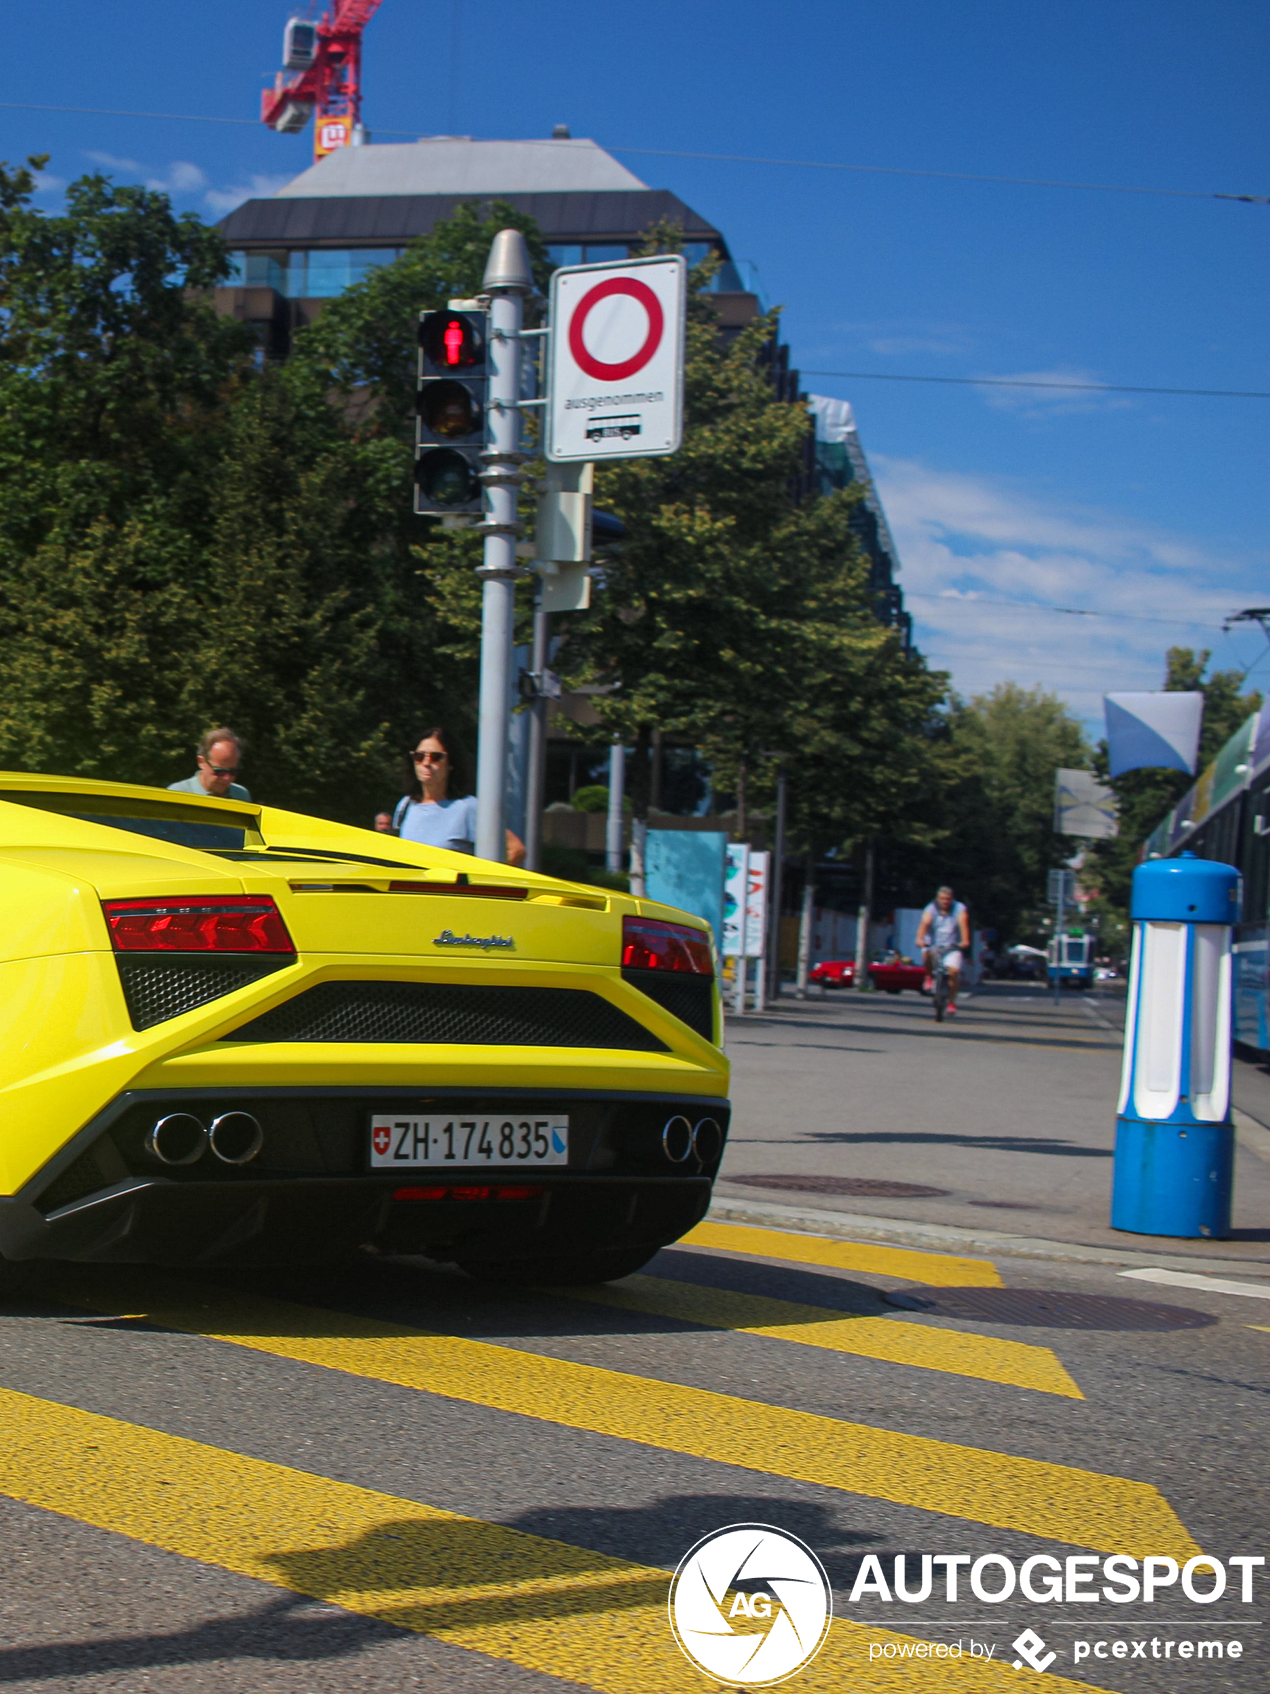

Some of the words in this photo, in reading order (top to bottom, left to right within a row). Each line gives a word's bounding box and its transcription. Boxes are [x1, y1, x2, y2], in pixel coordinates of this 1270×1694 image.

[564, 391, 663, 412] ausgenommen
[601, 427, 623, 438] BUS
[431, 929, 513, 949] Lamborghini
